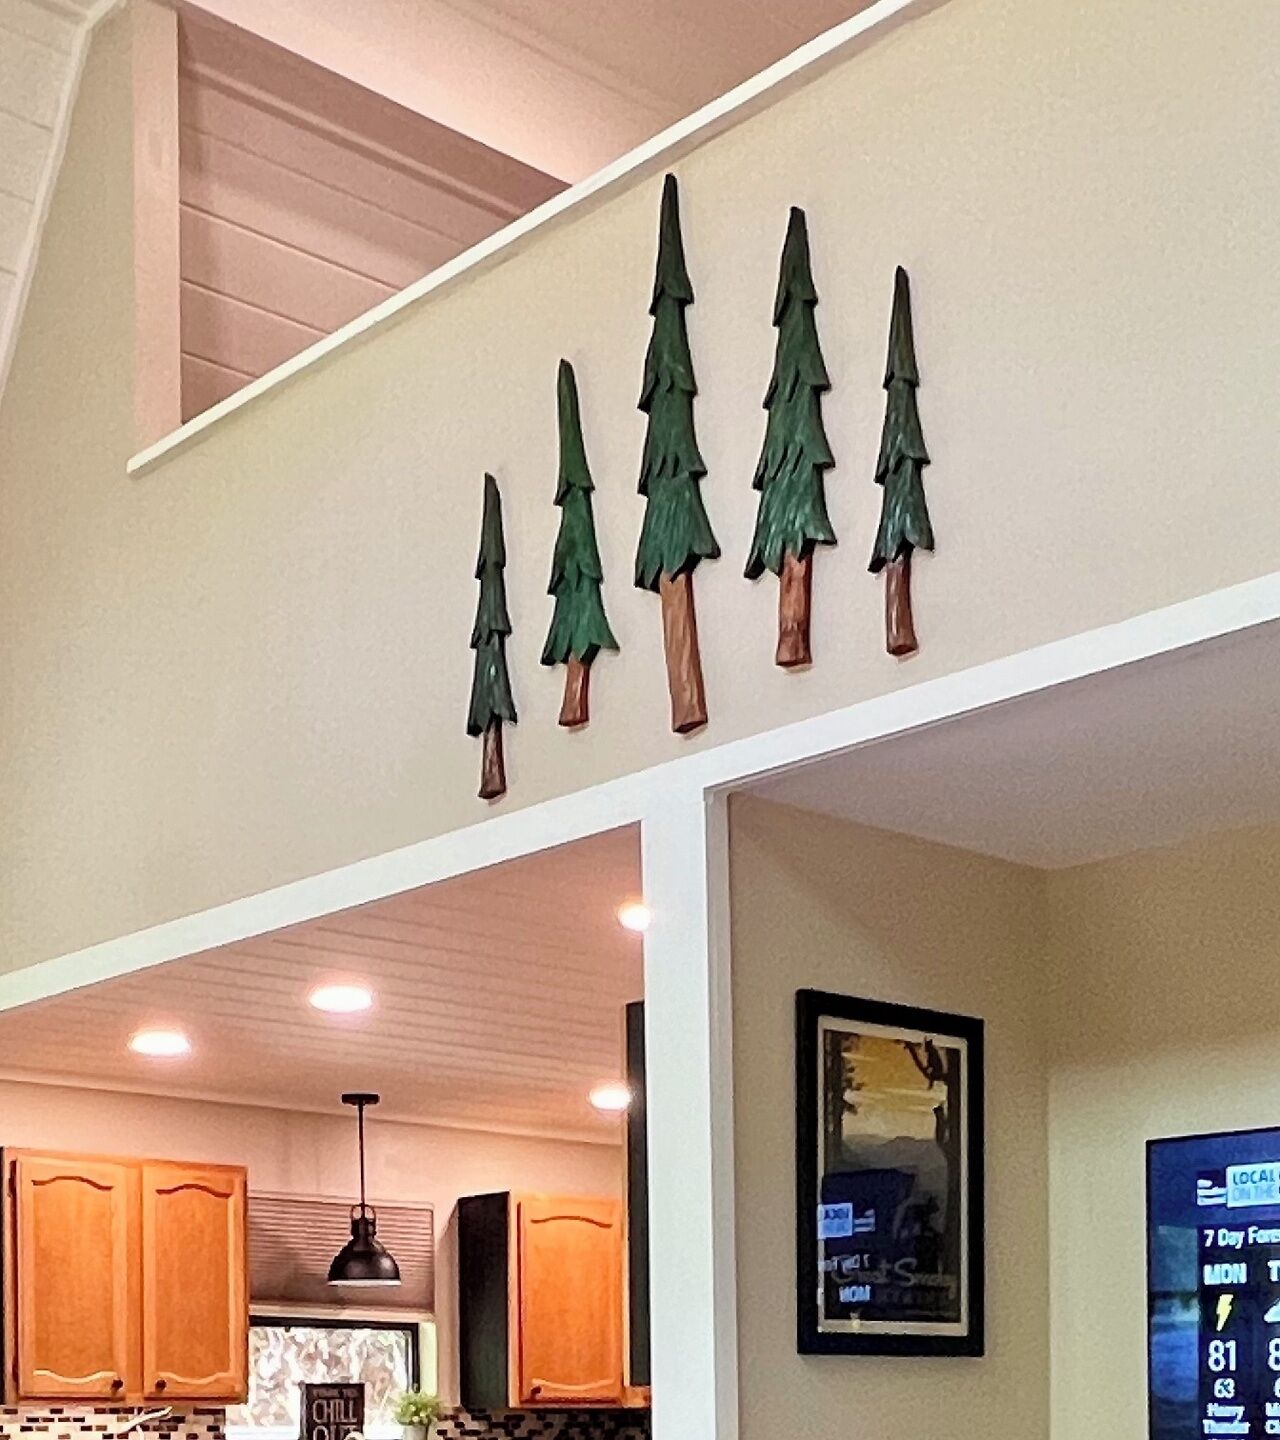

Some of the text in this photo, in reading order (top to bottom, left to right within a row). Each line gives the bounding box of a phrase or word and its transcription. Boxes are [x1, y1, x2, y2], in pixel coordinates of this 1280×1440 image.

[1232, 1168, 1276, 1185] LOCAL
[1204, 1229, 1214, 1248] 7
[1218, 1228, 1245, 1249] Day
[1203, 1262, 1247, 1286] MON
[1208, 1339, 1237, 1372] 81
[312, 1398, 358, 1424] CHILL
